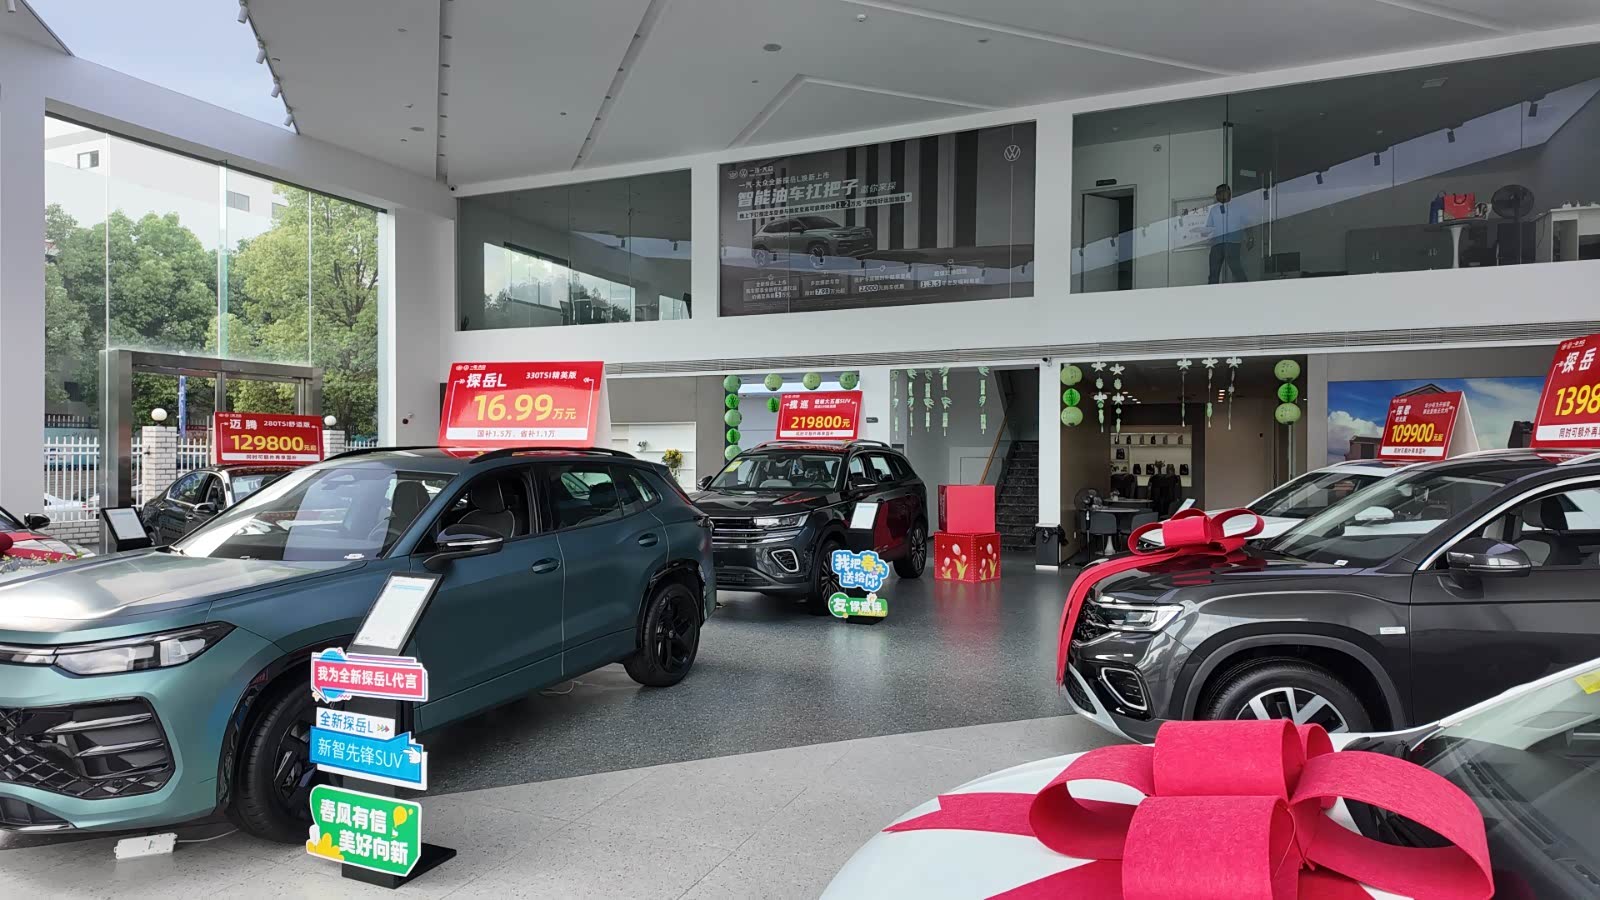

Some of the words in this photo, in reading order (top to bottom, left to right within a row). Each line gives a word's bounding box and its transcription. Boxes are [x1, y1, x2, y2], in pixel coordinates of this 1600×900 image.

[737, 179, 859, 207] 智能油车扛把子
[1561, 347, 1597, 374] 探岳
[466, 372, 507, 388] 探岳L
[525, 371, 577, 380] 330TSI精英版
[1559, 427, 1600, 438] 同时可额外再
[843, 572, 879, 588] 送给你
[317, 665, 419, 690] 我为全新探岳L代言
[320, 711, 374, 734] 全新探岳L
[317, 738, 404, 770] 新智先锋SUV
[319, 799, 388, 835] 春风有信
[338, 828, 409, 866] 美好向新
